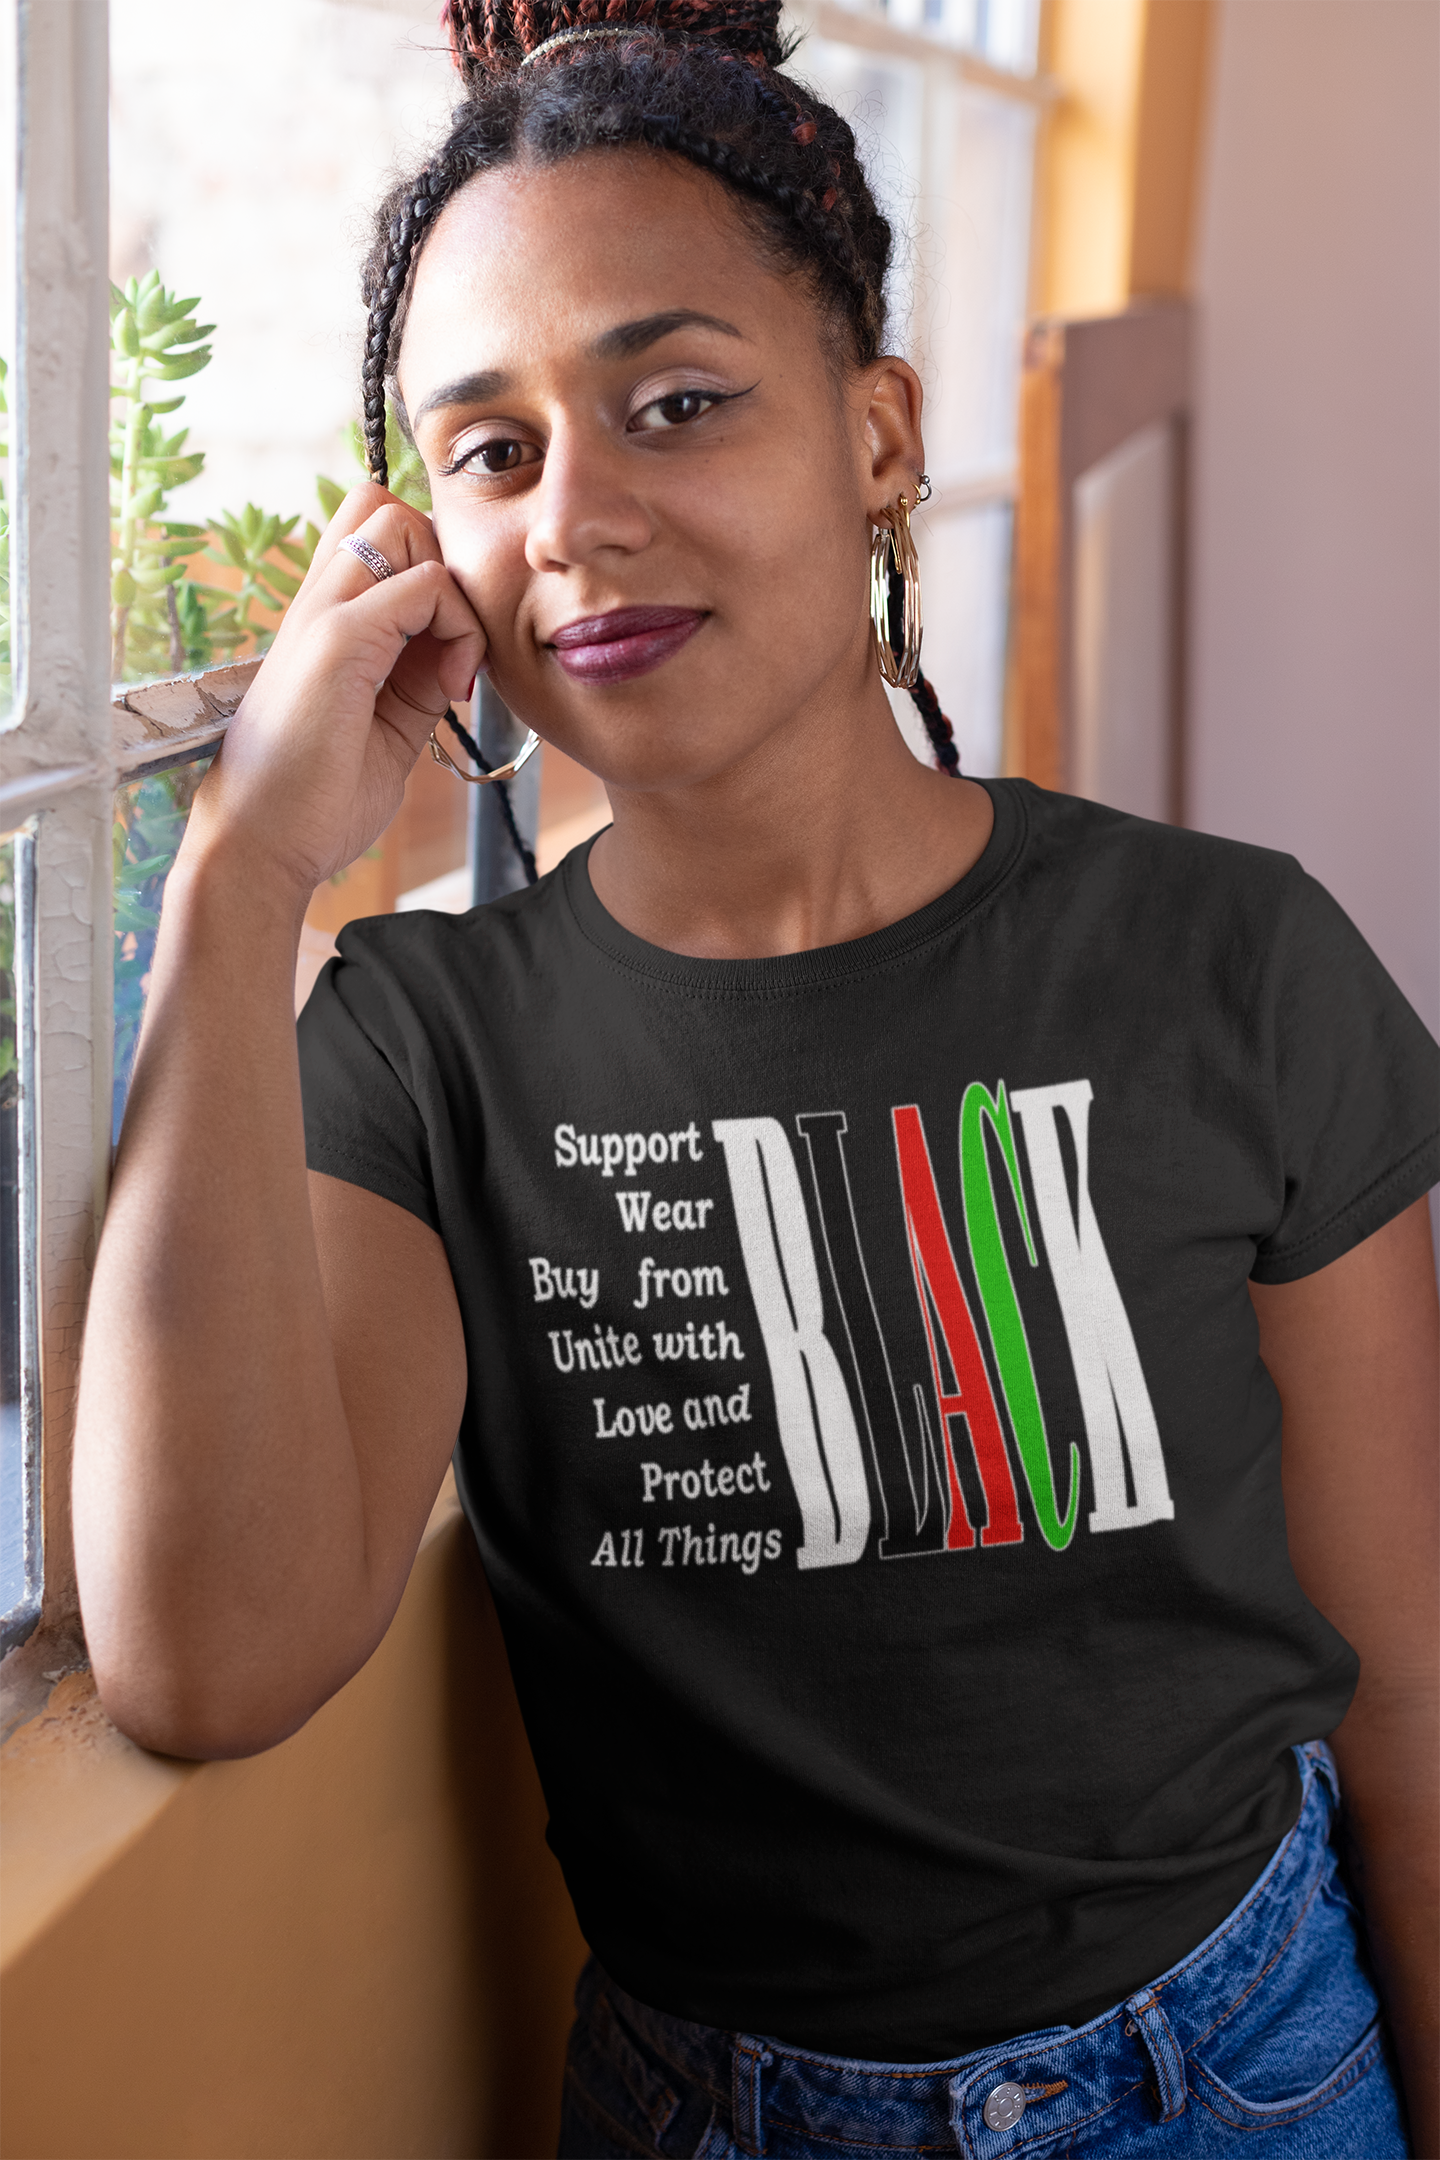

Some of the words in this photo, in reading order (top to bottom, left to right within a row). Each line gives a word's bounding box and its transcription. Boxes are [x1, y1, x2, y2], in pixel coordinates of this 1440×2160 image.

[554, 1121, 704, 1178] Support
[614, 1190, 714, 1233] Wear
[528, 1256, 599, 1309] Buy
[633, 1256, 730, 1310] from
[547, 1325, 642, 1373] Unite
[652, 1320, 745, 1361] with
[711, 1078, 1175, 1570] BLACK
[593, 1398, 674, 1439] Love
[683, 1383, 752, 1431] and
[640, 1452, 771, 1502] Protect
[590, 1529, 644, 1567] All
[658, 1523, 783, 1575] Things
